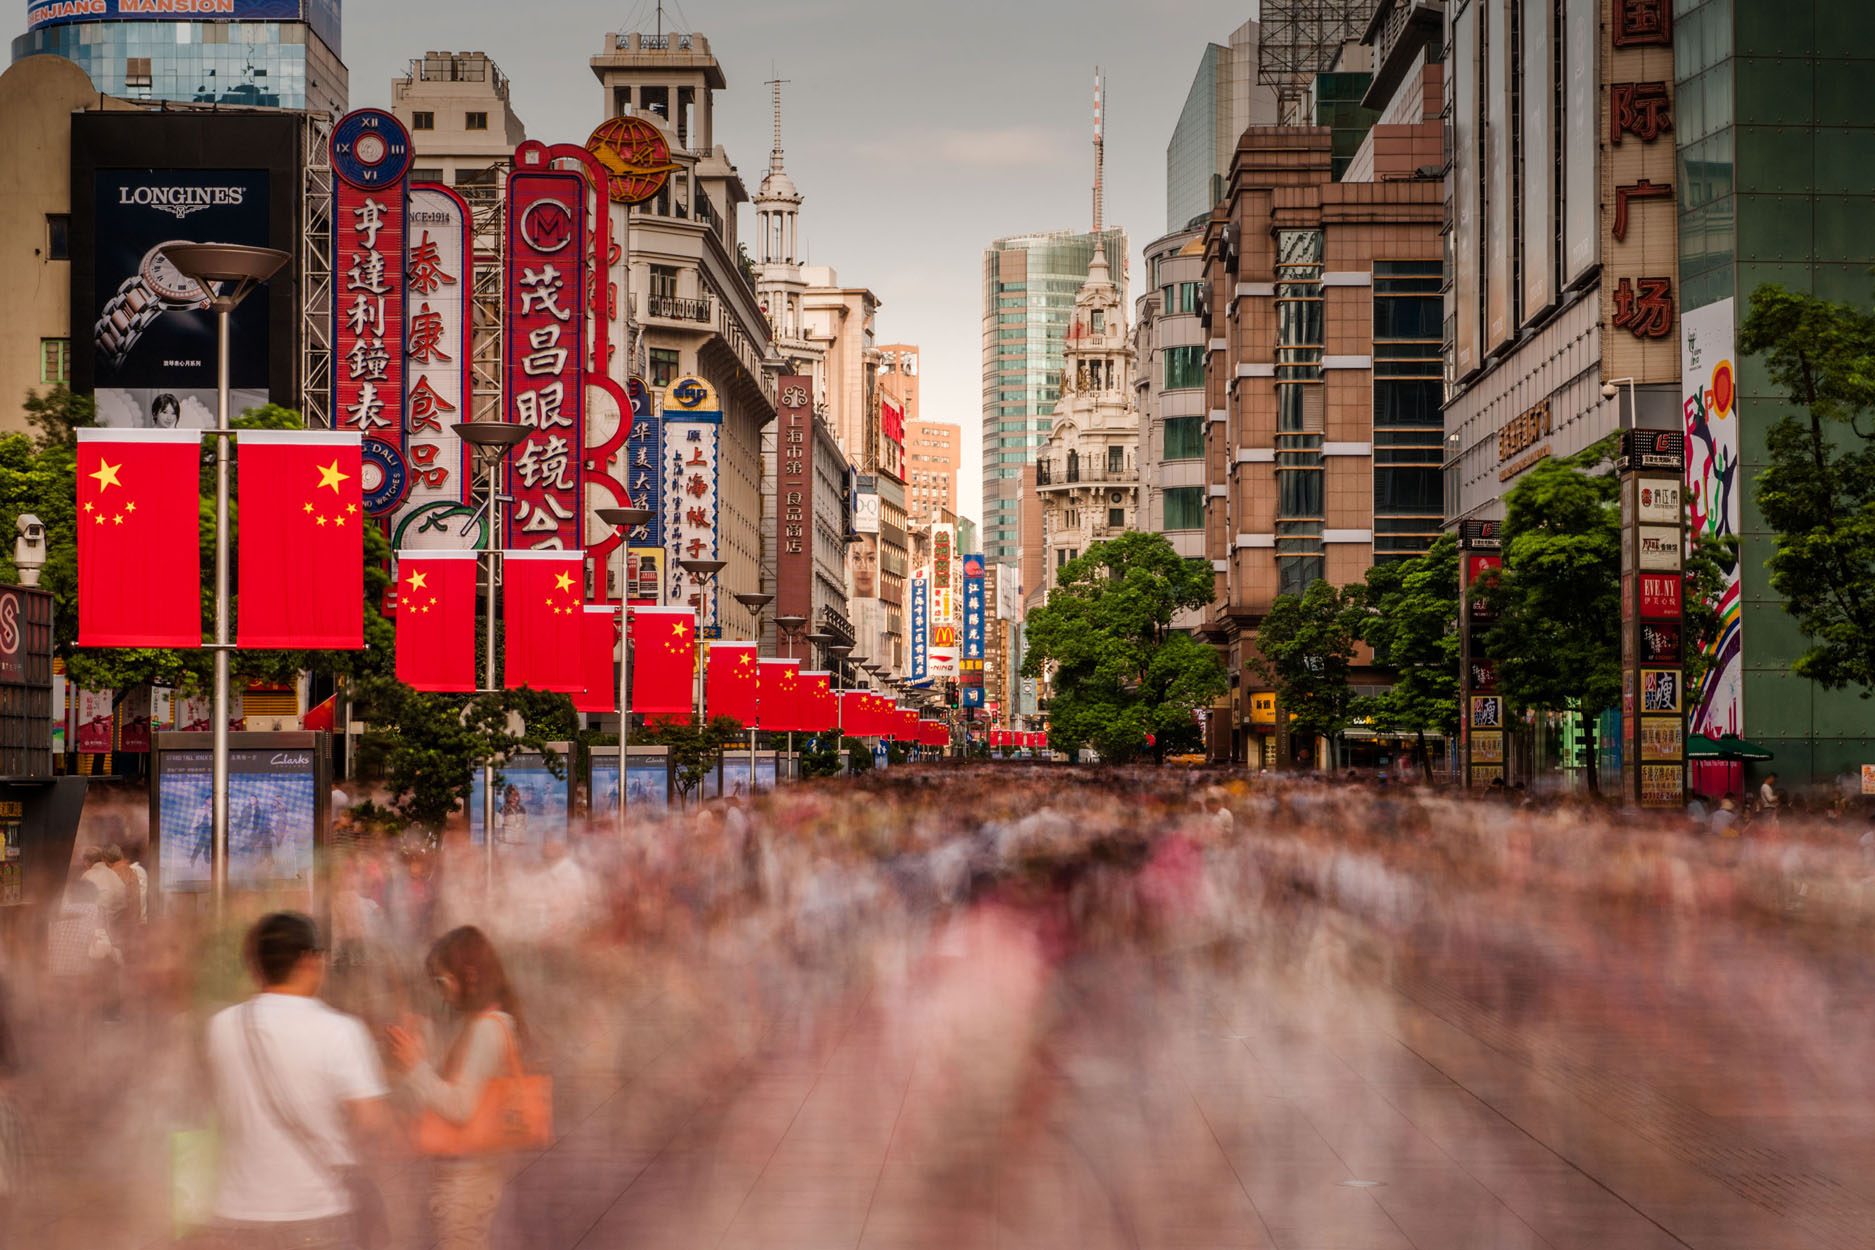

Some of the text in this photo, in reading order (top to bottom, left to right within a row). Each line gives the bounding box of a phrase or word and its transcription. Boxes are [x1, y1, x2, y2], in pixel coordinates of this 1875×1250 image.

[119, 0, 234, 12] MANSION
[1611, 0, 1673, 339] 国际广场
[119, 186, 244, 205] LONGINES
[409, 230, 457, 489] 泰康食品
[376, 472, 401, 505] WATCHES
[786, 414, 804, 553] 上海市第一食品商店
[270, 752, 310, 765] Clarks
